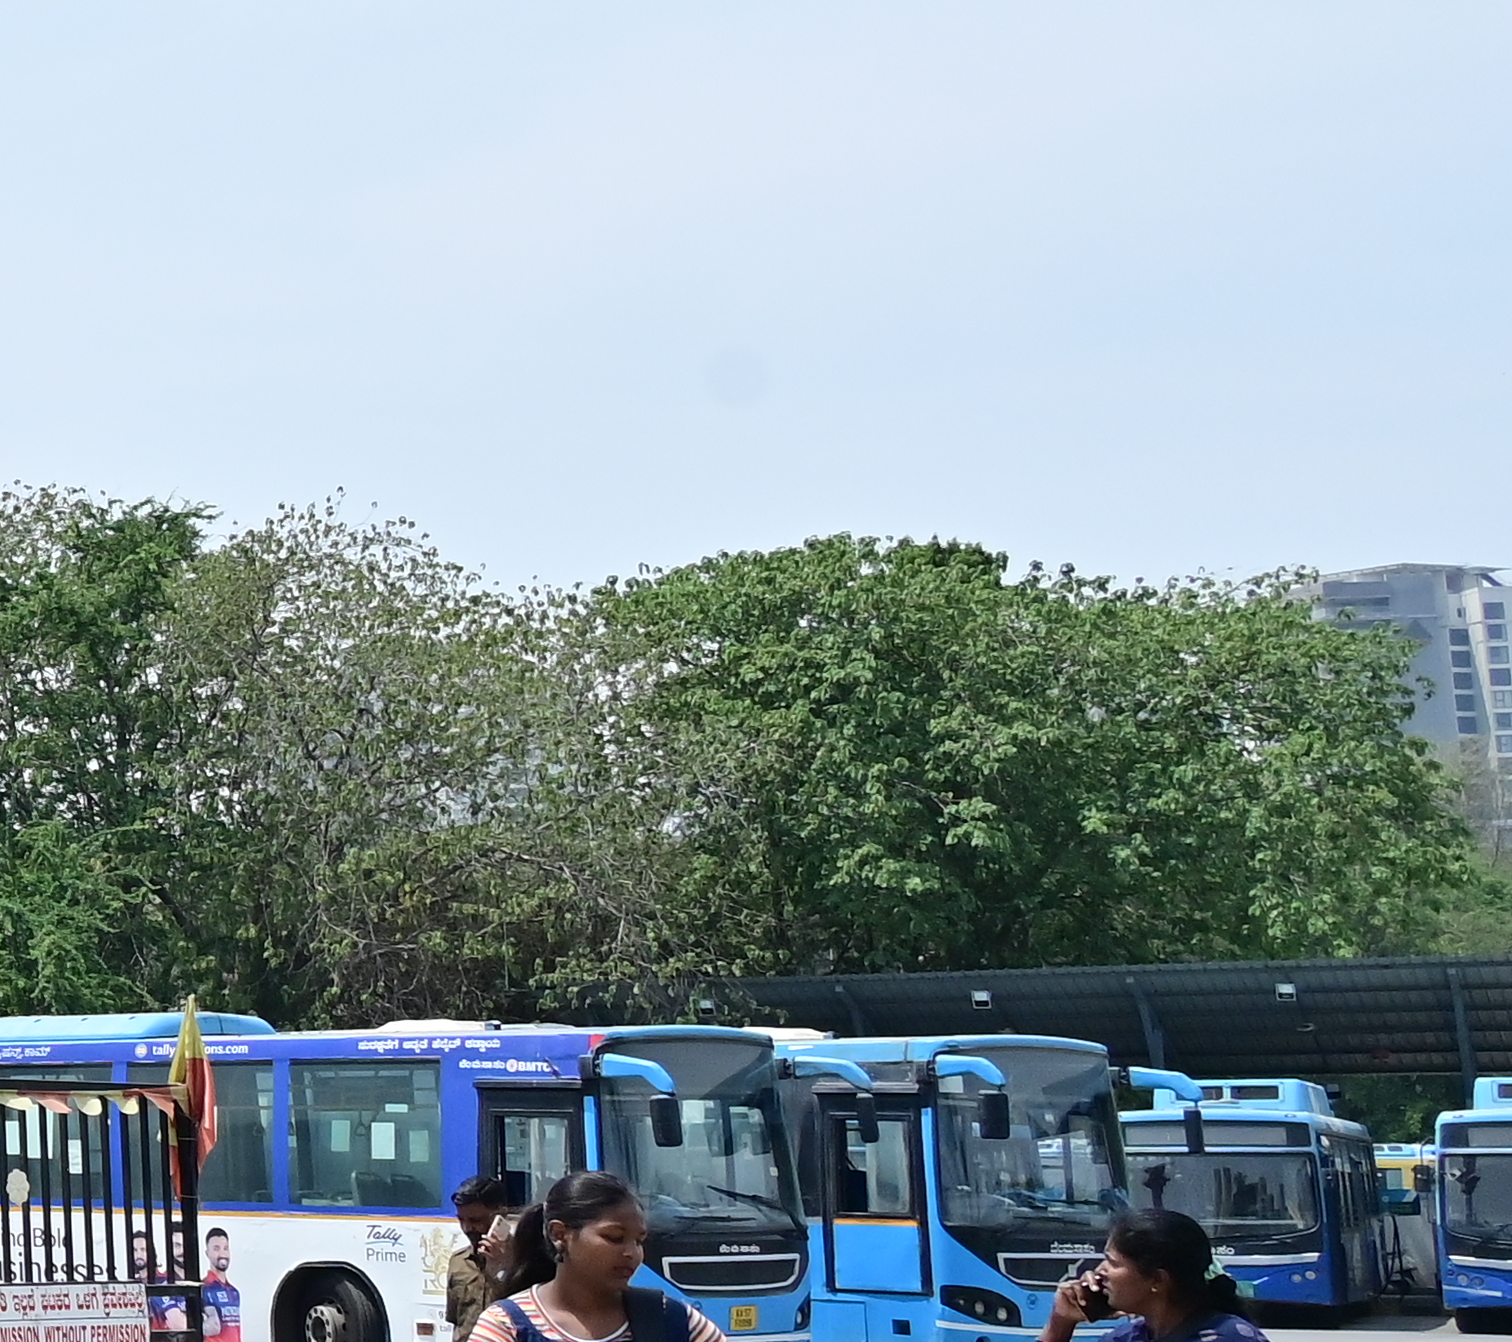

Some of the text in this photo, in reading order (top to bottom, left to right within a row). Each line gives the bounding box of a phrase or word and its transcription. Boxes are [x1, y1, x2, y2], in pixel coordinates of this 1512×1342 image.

[152, 1044, 249, 1058] tallyons.com
[366, 1225, 402, 1247] Tally
[366, 1248, 406, 1262] Prime
